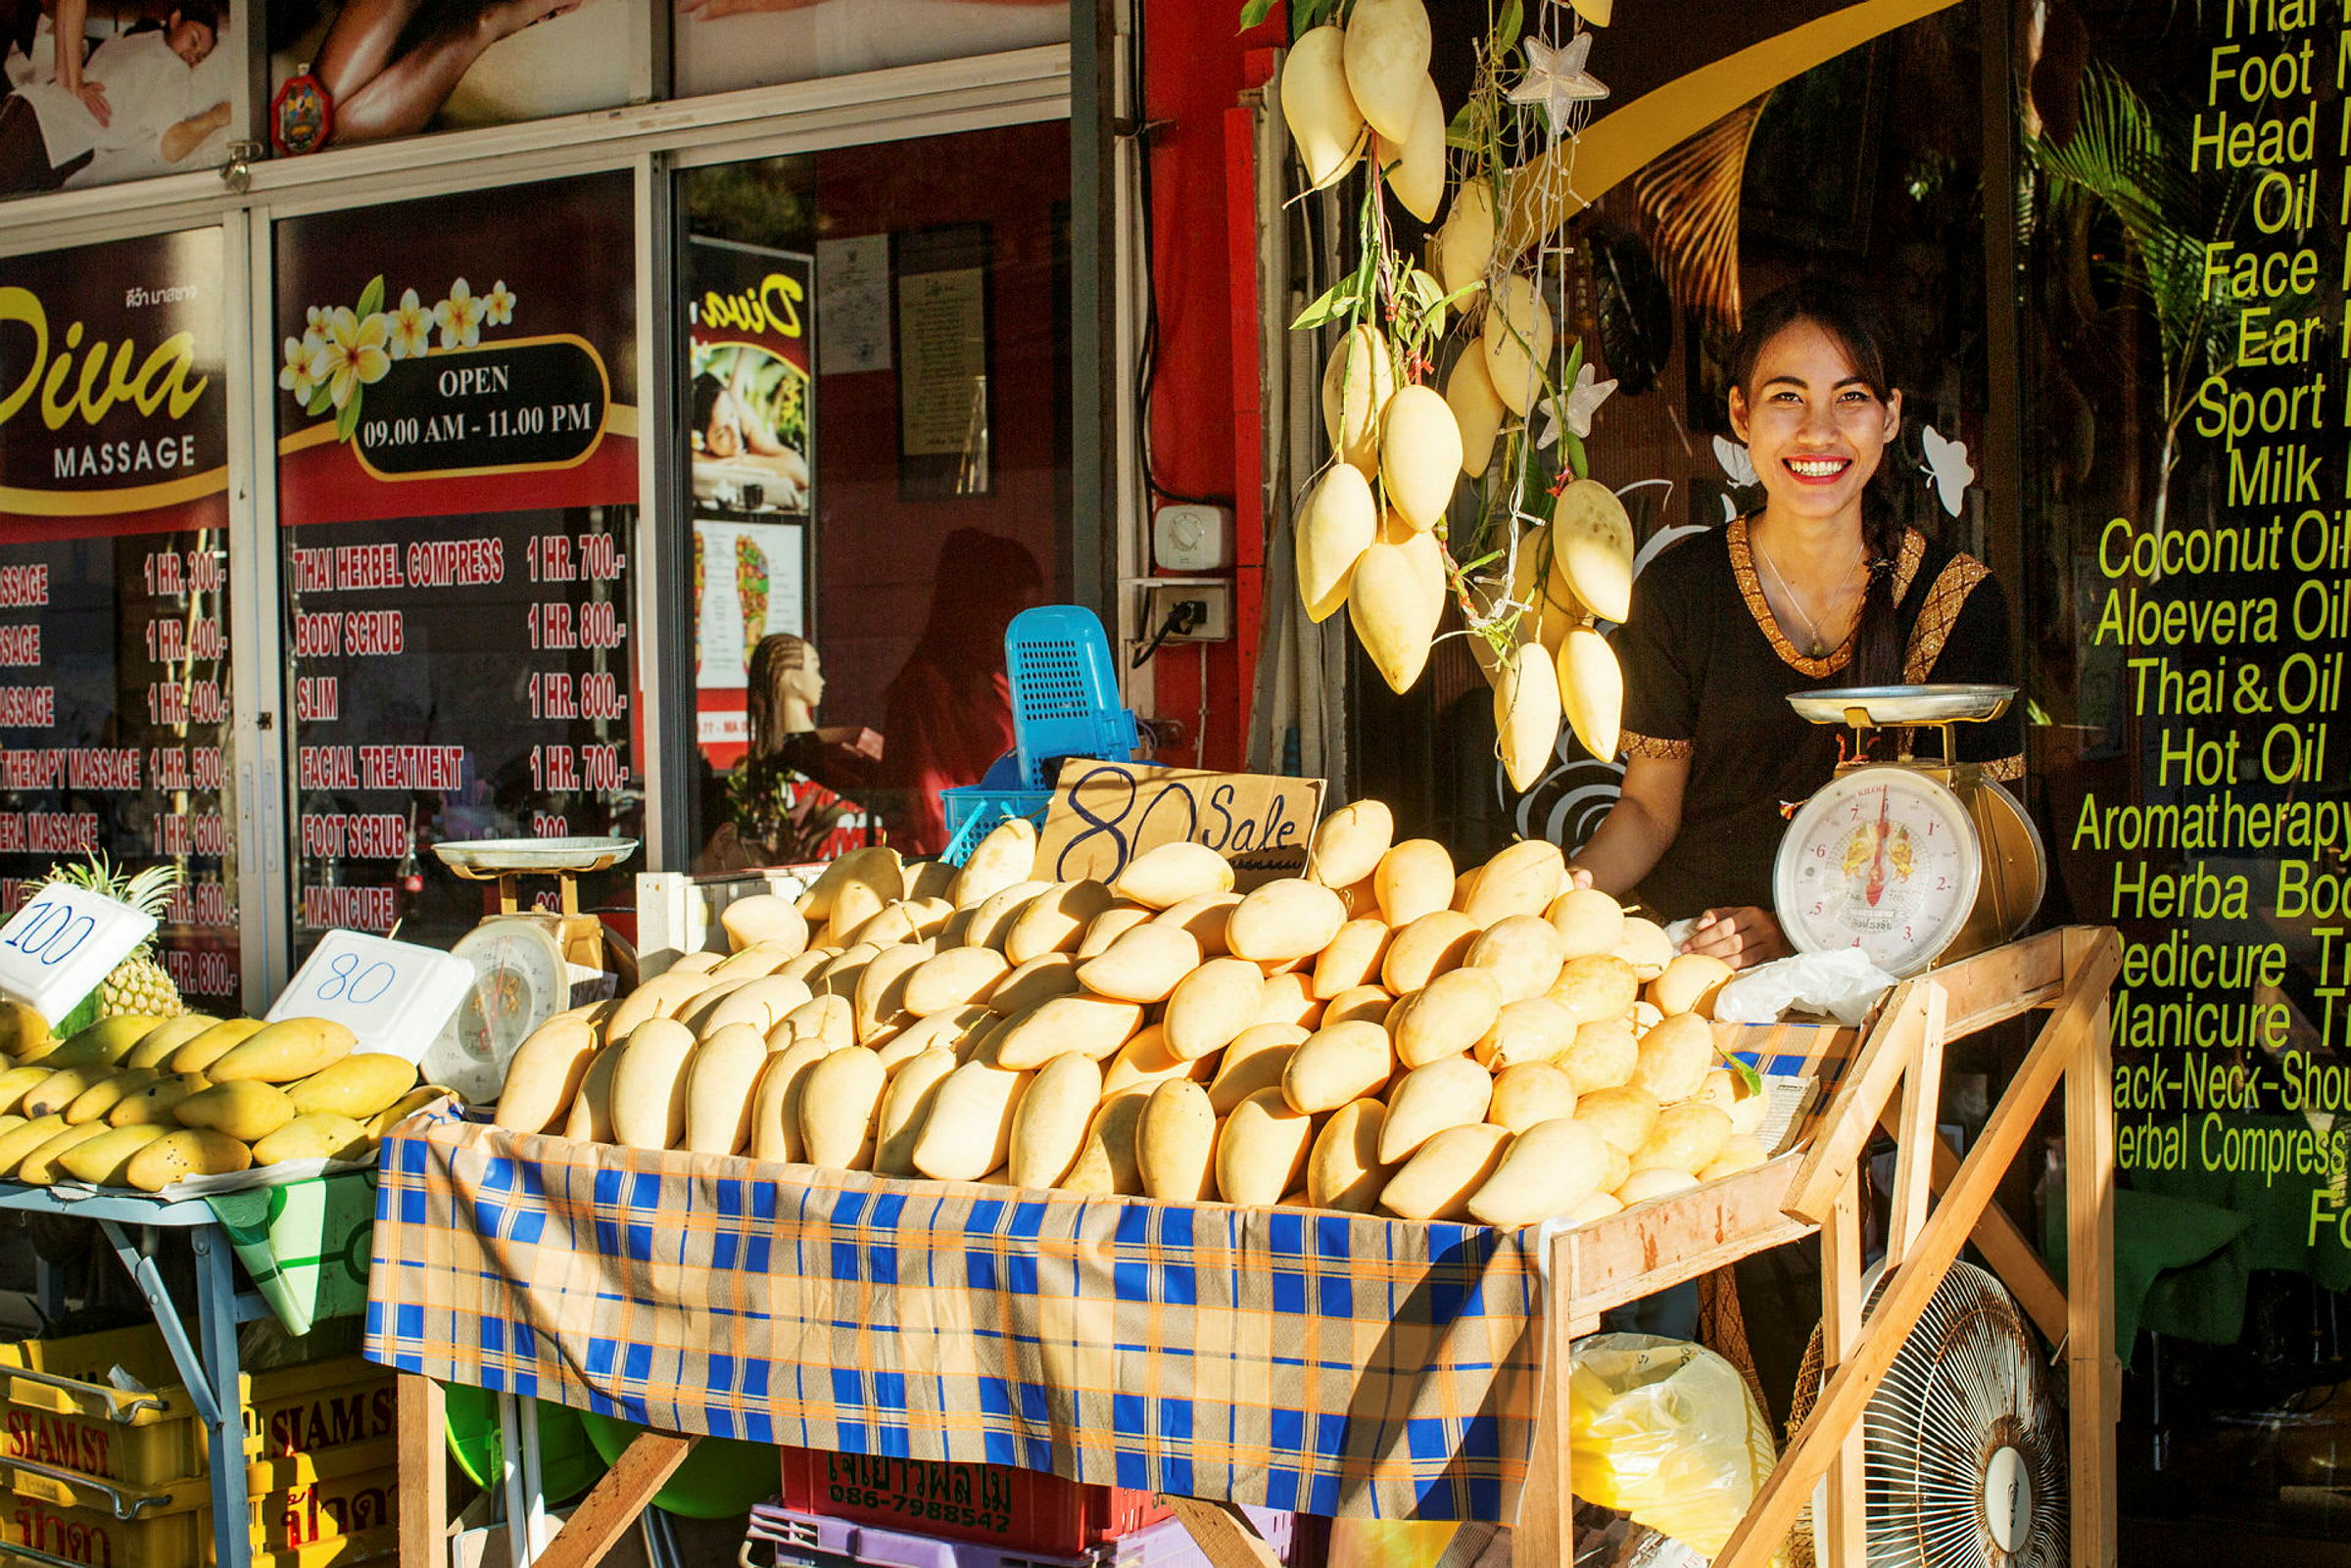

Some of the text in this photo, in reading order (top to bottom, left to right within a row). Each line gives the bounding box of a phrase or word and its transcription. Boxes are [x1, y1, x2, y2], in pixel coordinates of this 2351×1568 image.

[2208, 39, 2314, 107] Foot
[2190, 100, 2318, 173] Head
[2253, 168, 2318, 234] Oil
[2202, 240, 2319, 303] Face
[2237, 307, 2321, 368] Ear
[439, 364, 509, 398] OPEN
[362, 417, 419, 449] 09.00
[423, 412, 466, 444] AM
[488, 406, 545, 439] 11.00
[551, 402, 593, 433] PM
[2195, 372, 2327, 453] Sport
[54, 434, 196, 479] MASSAGE
[2228, 444, 2324, 507] Milk
[293, 537, 504, 593] THAI HERBEL COMPRESS
[527, 532, 626, 582] 1 HR. 700.-
[2099, 508, 2351, 579] Coconut Oil
[0, 563, 49, 607] SSAGE
[144, 553, 155, 595] 1
[157, 552, 186, 595] HR.
[296, 610, 405, 657] BODY SCRUB
[528, 601, 627, 649] 1 HR. 800.-
[2093, 578, 2350, 645] Aloevera Oil
[146, 618, 228, 662] 1 HR. 400.-
[148, 683, 158, 725] 1
[160, 682, 189, 724] HR.
[297, 676, 338, 721] SLIM
[528, 672, 627, 720] 1 HR. 800.-
[2127, 651, 2344, 716] Thai & Oil
[0, 748, 141, 790] THERAPY MASSAGE
[150, 748, 159, 789] 1
[163, 747, 192, 789] HR.
[300, 744, 464, 790] FACIAL TREATMENT
[529, 743, 629, 791] 1 HR. 700.-
[2158, 722, 2327, 786] Hot Oil
[28, 813, 99, 853] MASSAGE
[153, 813, 234, 856] 1 HR. 600.-
[302, 813, 407, 859] FOOT SCRUB
[1056, 766, 1296, 885] 80 Sale
[304, 885, 394, 930] MANICURE
[2111, 860, 2248, 920] Herba
[4, 901, 96, 966] 100
[2117, 928, 2287, 988] edicure
[199, 951, 238, 996] 800.-
[316, 952, 397, 1004] 80
[2113, 1112, 2346, 1188] erbal Compress
[7, 1409, 80, 1470] SIAM
[270, 1385, 398, 1459] SIAM S
[281, 1482, 398, 1550] ป้าด
[829, 1484, 1011, 1534] 086-7988542
